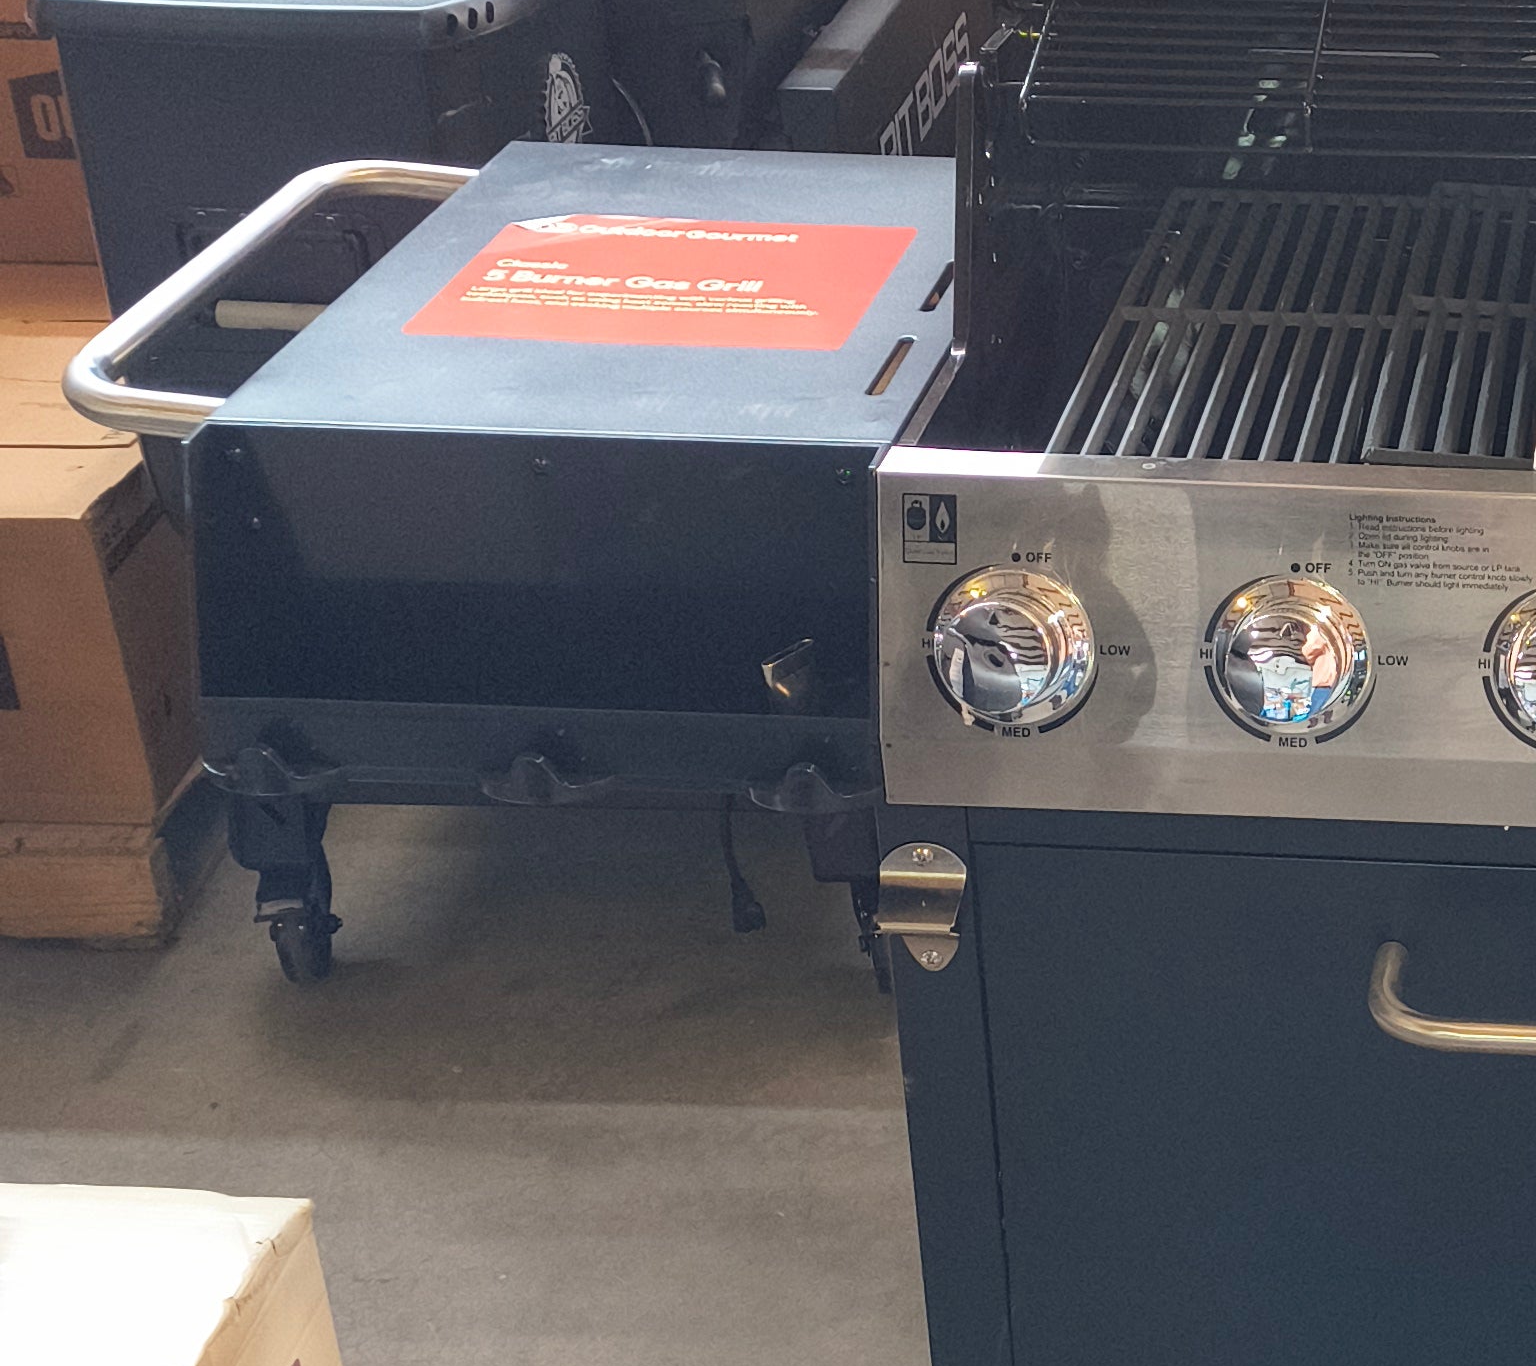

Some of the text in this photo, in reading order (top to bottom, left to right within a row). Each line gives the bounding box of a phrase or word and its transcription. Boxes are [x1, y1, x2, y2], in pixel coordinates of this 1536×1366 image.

[914, 11, 970, 143] BOSS
[579, 223, 686, 240] Outdoor
[687, 229, 800, 244] Gourmet
[483, 269, 764, 294] 5 Burner Gas Grill
[1385, 515, 1437, 524] Instructions
[1025, 551, 1053, 564] OFF
[1304, 562, 1332, 574] OFF
[1099, 644, 1131, 657] LOW
[1199, 648, 1213, 660] HI
[1377, 655, 1409, 667] LOW
[1478, 658, 1491, 670] HI
[1001, 726, 1031, 738] MED
[1278, 737, 1308, 749] MED
